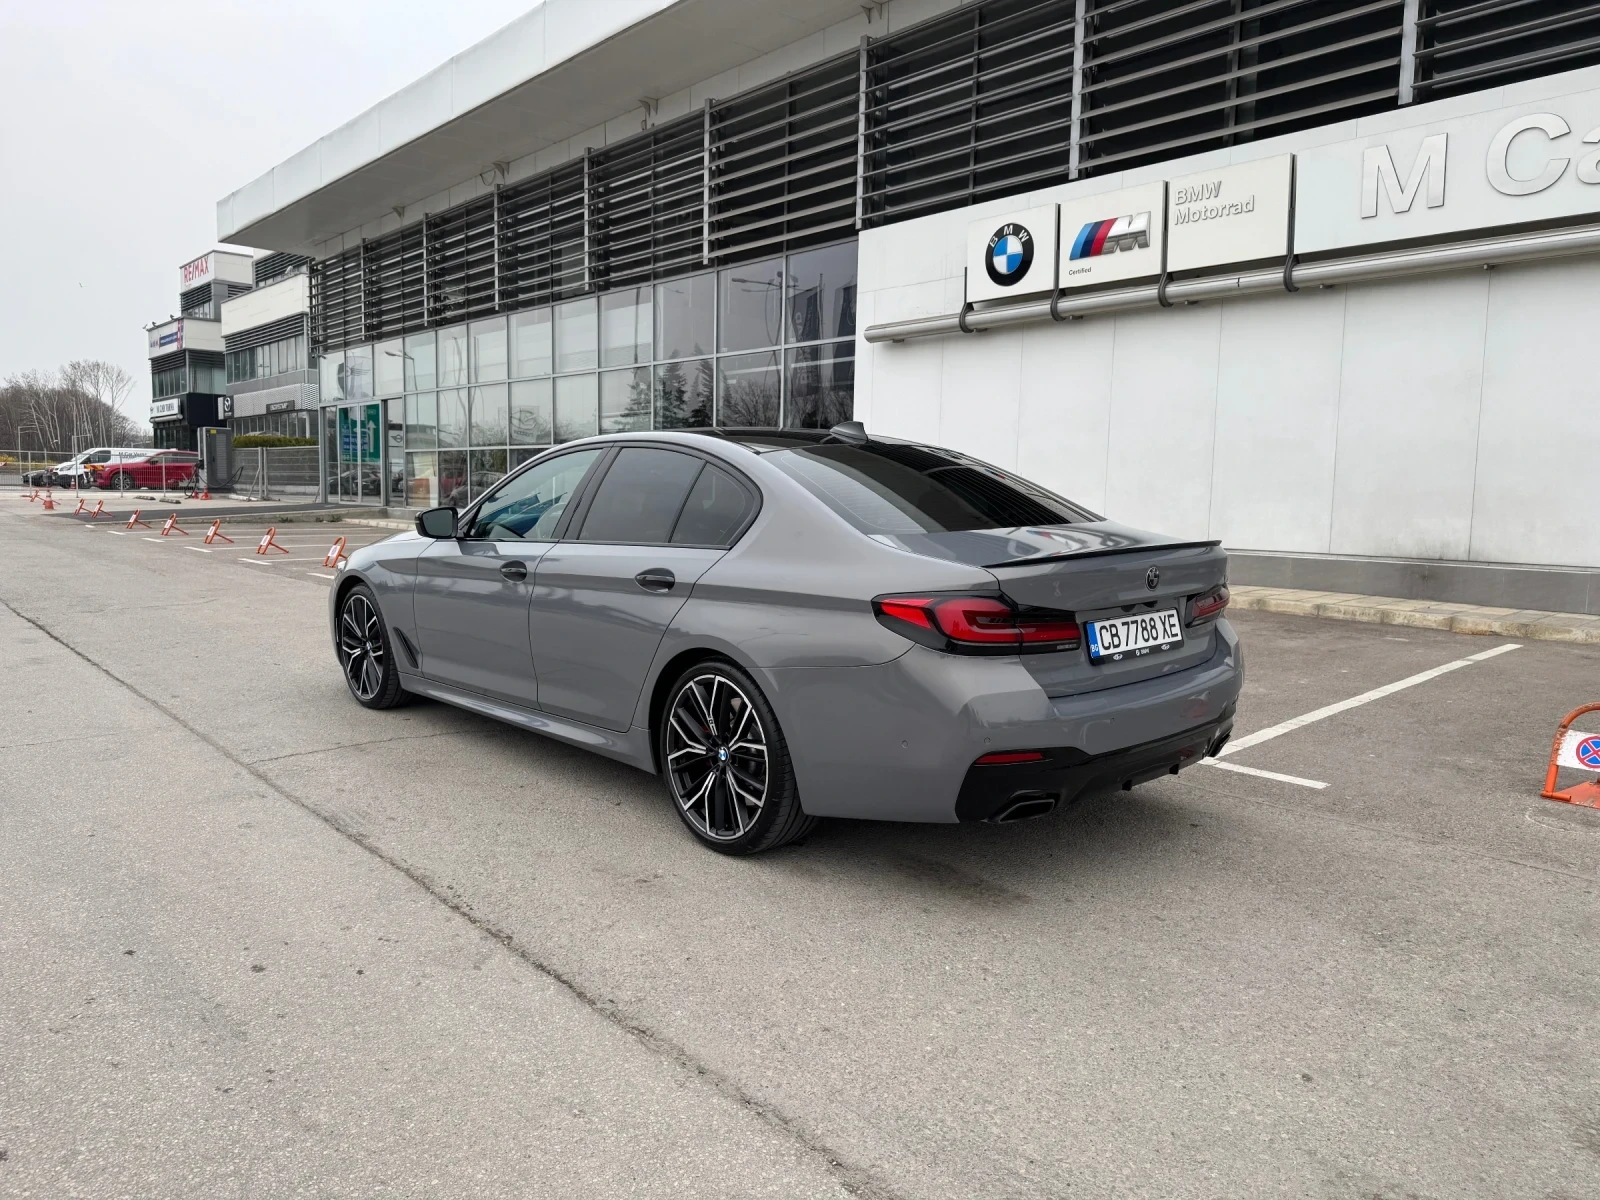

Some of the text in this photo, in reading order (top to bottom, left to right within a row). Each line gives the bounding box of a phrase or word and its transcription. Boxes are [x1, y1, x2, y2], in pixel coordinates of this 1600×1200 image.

[1361, 132, 1448, 220] M
[1174, 180, 1222, 206] BMW
[1174, 194, 1255, 226] Motorrad
[989, 224, 1030, 248] BMW
[183, 255, 210, 284] RE/MAX
[1068, 266, 1092, 276] Certified
[1099, 613, 1179, 651] CB 7788 XE
[1090, 644, 1099, 653] BG
